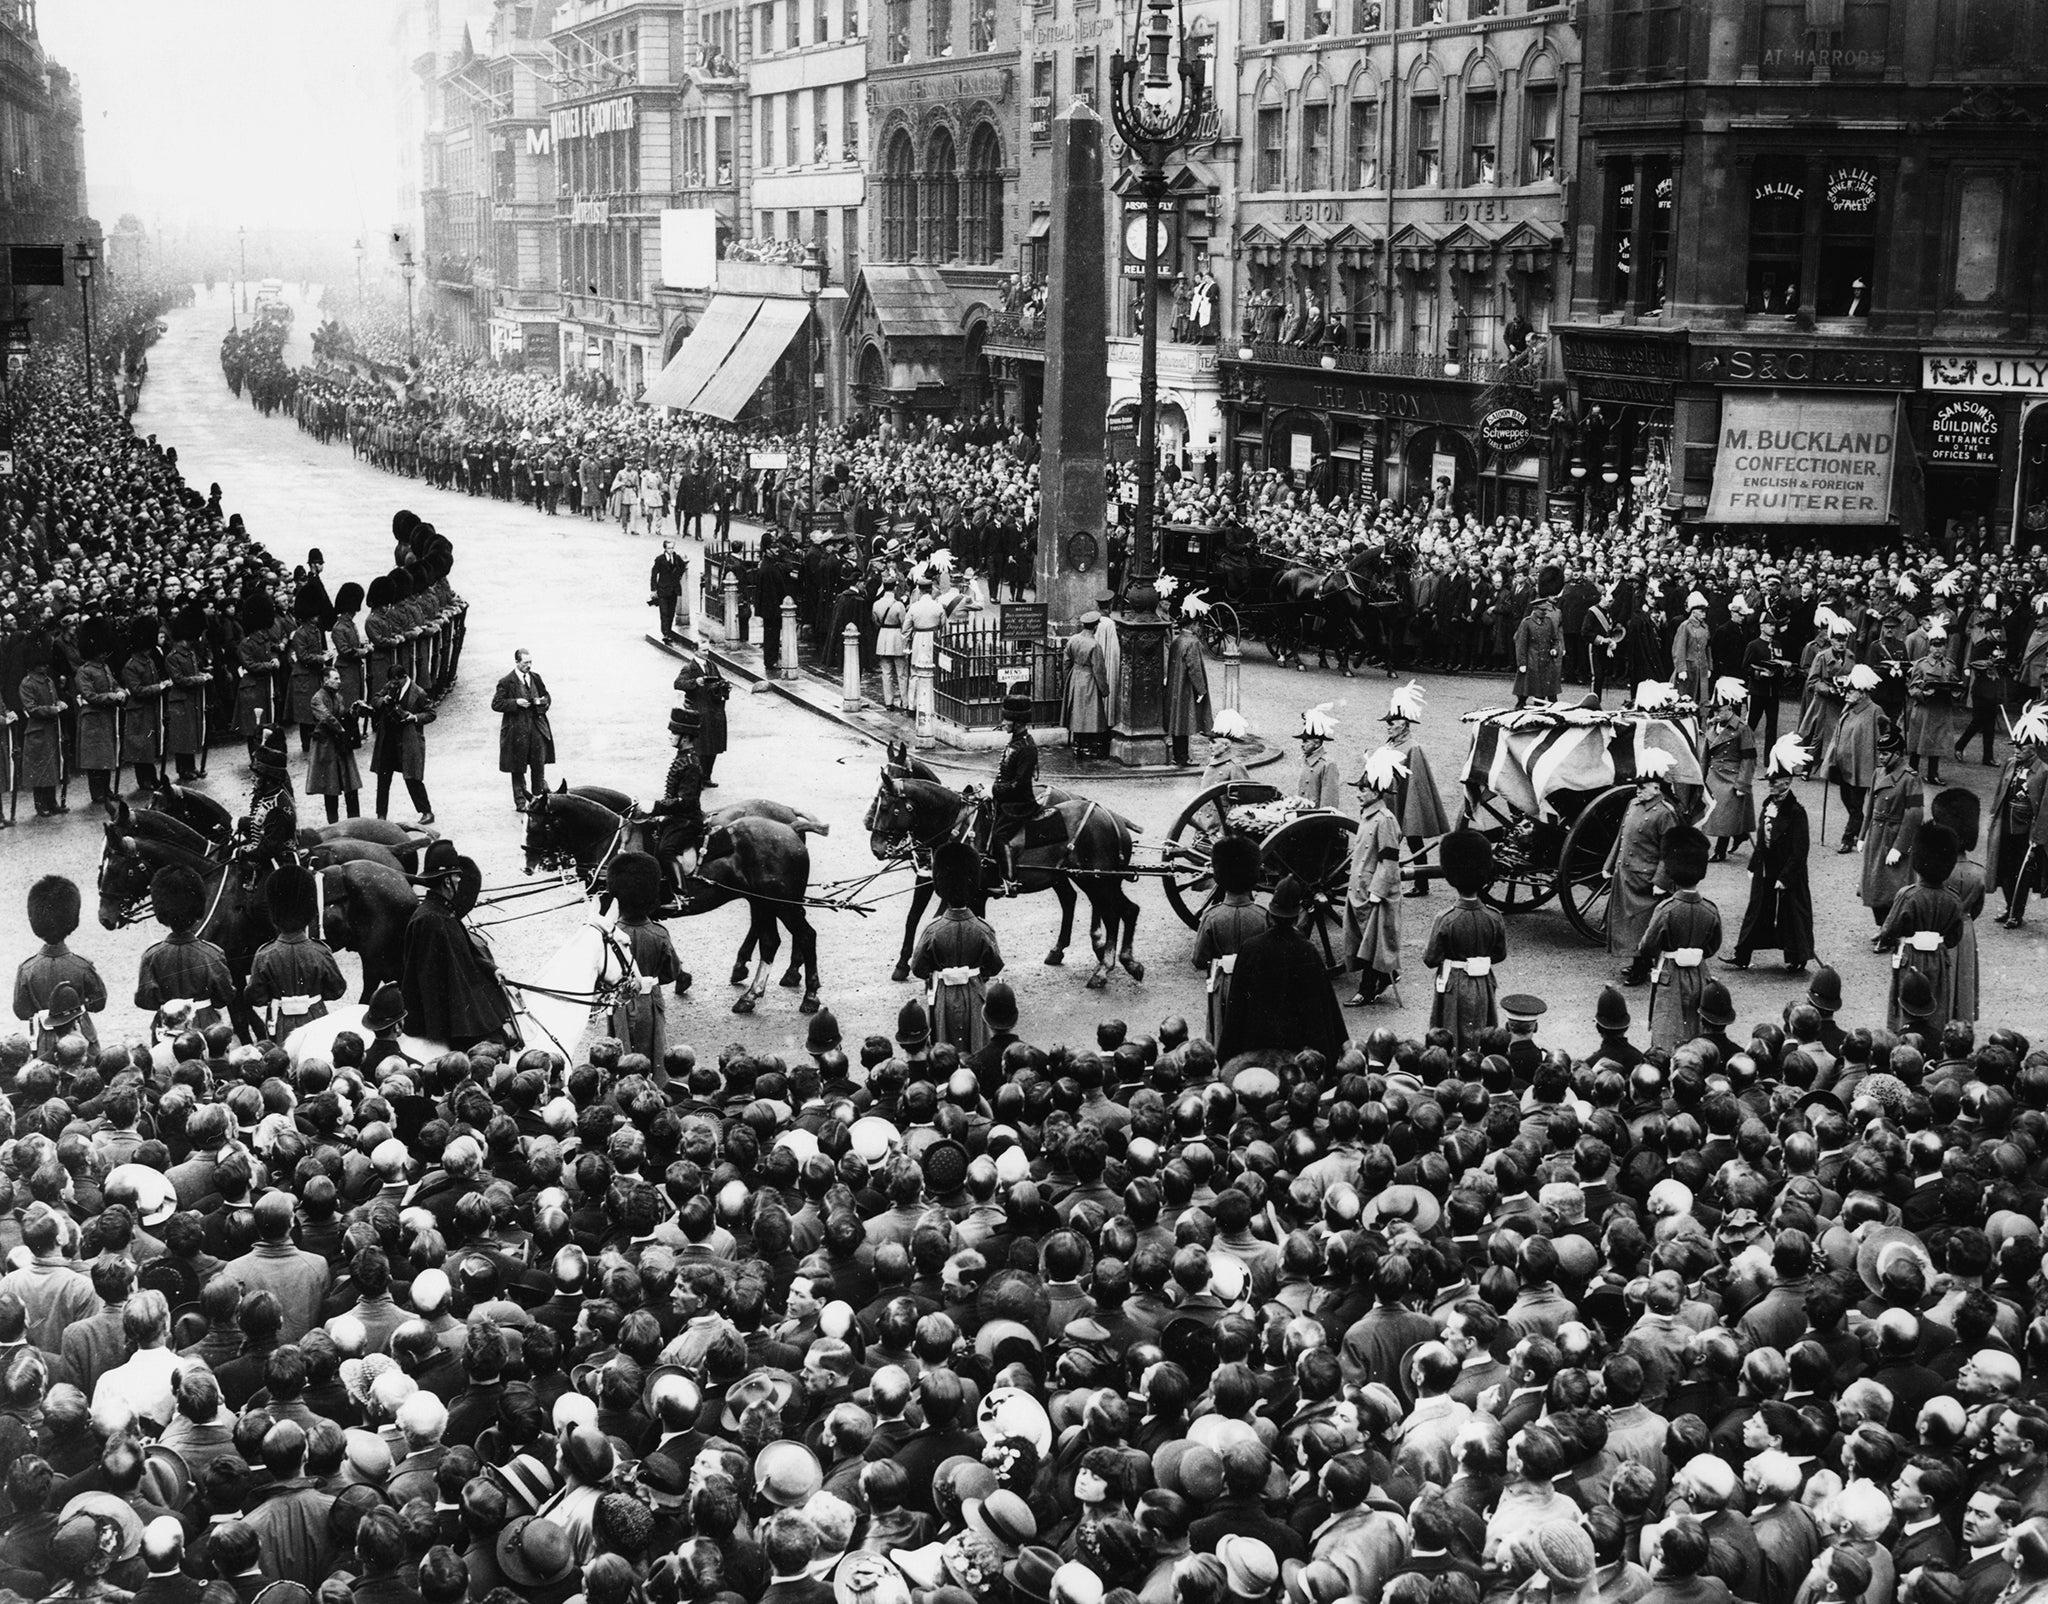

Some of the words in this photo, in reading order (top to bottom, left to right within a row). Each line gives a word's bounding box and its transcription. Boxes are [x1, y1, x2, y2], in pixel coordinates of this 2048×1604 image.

[1033, 24, 1074, 44] CENTRAL
[1075, 20, 1103, 43] NEWS
[1763, 49, 1783, 65] AT
[1793, 49, 1885, 65] HARRODS
[526, 128, 550, 154] M
[1827, 180, 1876, 200] ADVERISING
[1284, 203, 1344, 222] ALBION
[1444, 201, 1509, 221] HOTEL
[1123, 265, 1172, 275] RELILE
[1314, 386, 1345, 408] THE
[1357, 389, 1420, 417] ALBION
[1482, 426, 1530, 440] Schweppes
[1724, 429, 1753, 450] M.
[1756, 430, 1892, 455] BUCKLAND
[1937, 434, 1991, 445] ENTRANCE
[1932, 449, 1970, 460] OFFICES
[1743, 477, 1797, 488] ENGLISH
[1800, 481, 1808, 489] &
[1811, 479, 1864, 491] FOREIGN
[1730, 493, 1879, 511] FRUITERER.
